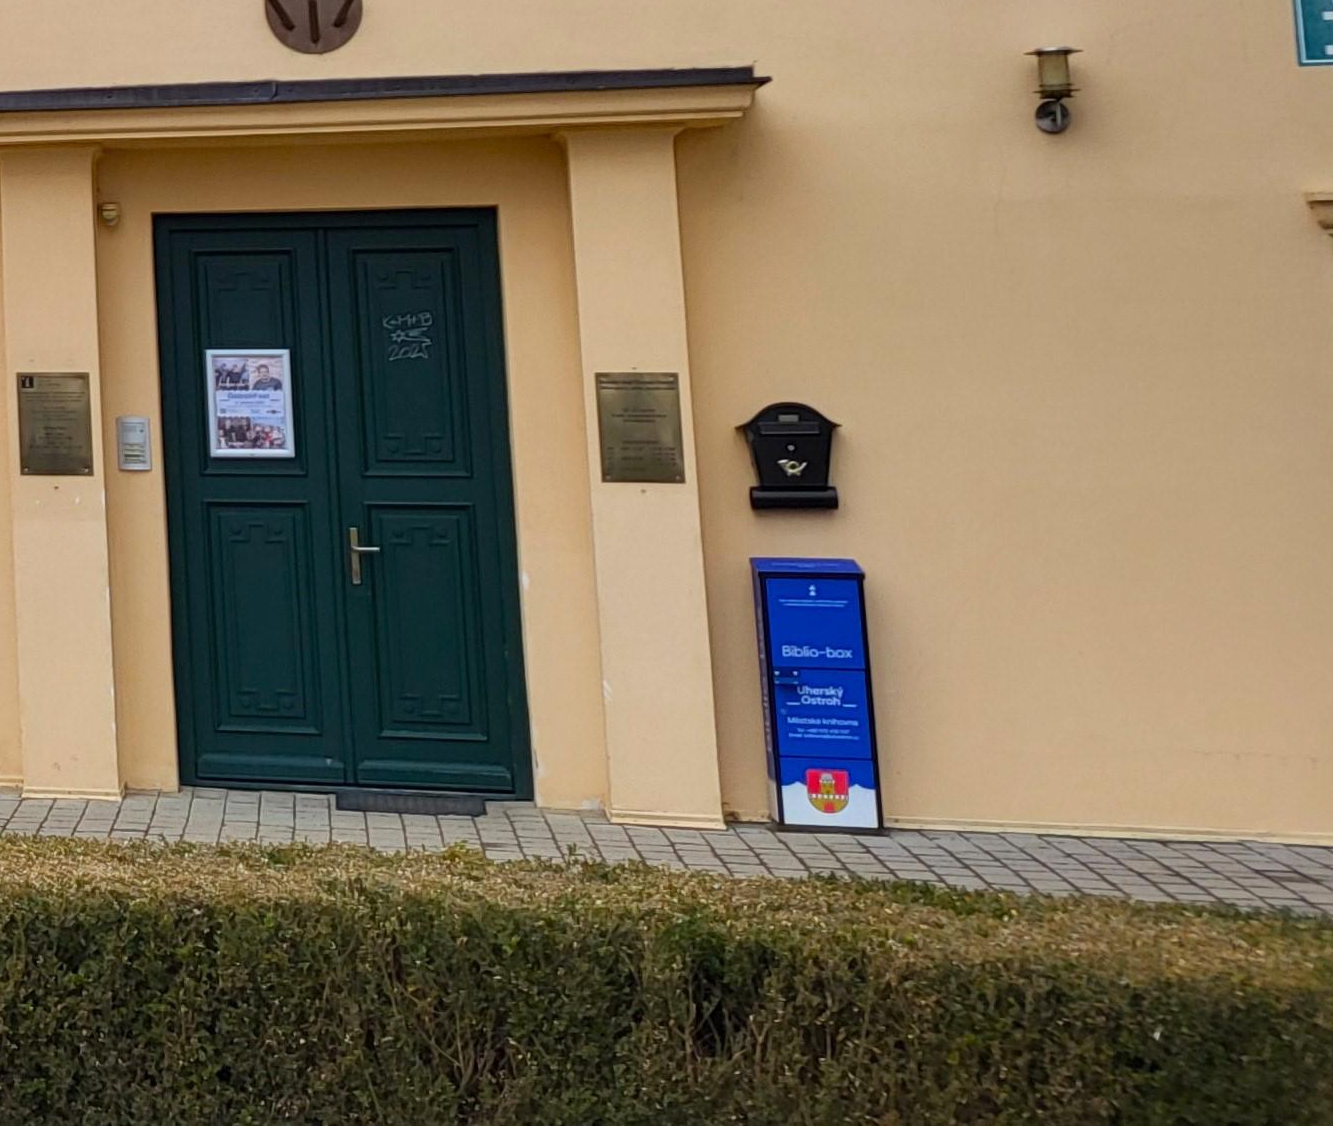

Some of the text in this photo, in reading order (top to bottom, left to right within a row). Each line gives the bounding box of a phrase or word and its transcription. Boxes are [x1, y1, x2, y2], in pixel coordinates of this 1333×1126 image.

[781, 644, 853, 659] Biblio-box
[796, 685, 844, 698] Uherský
[800, 695, 841, 706] Ostroh
